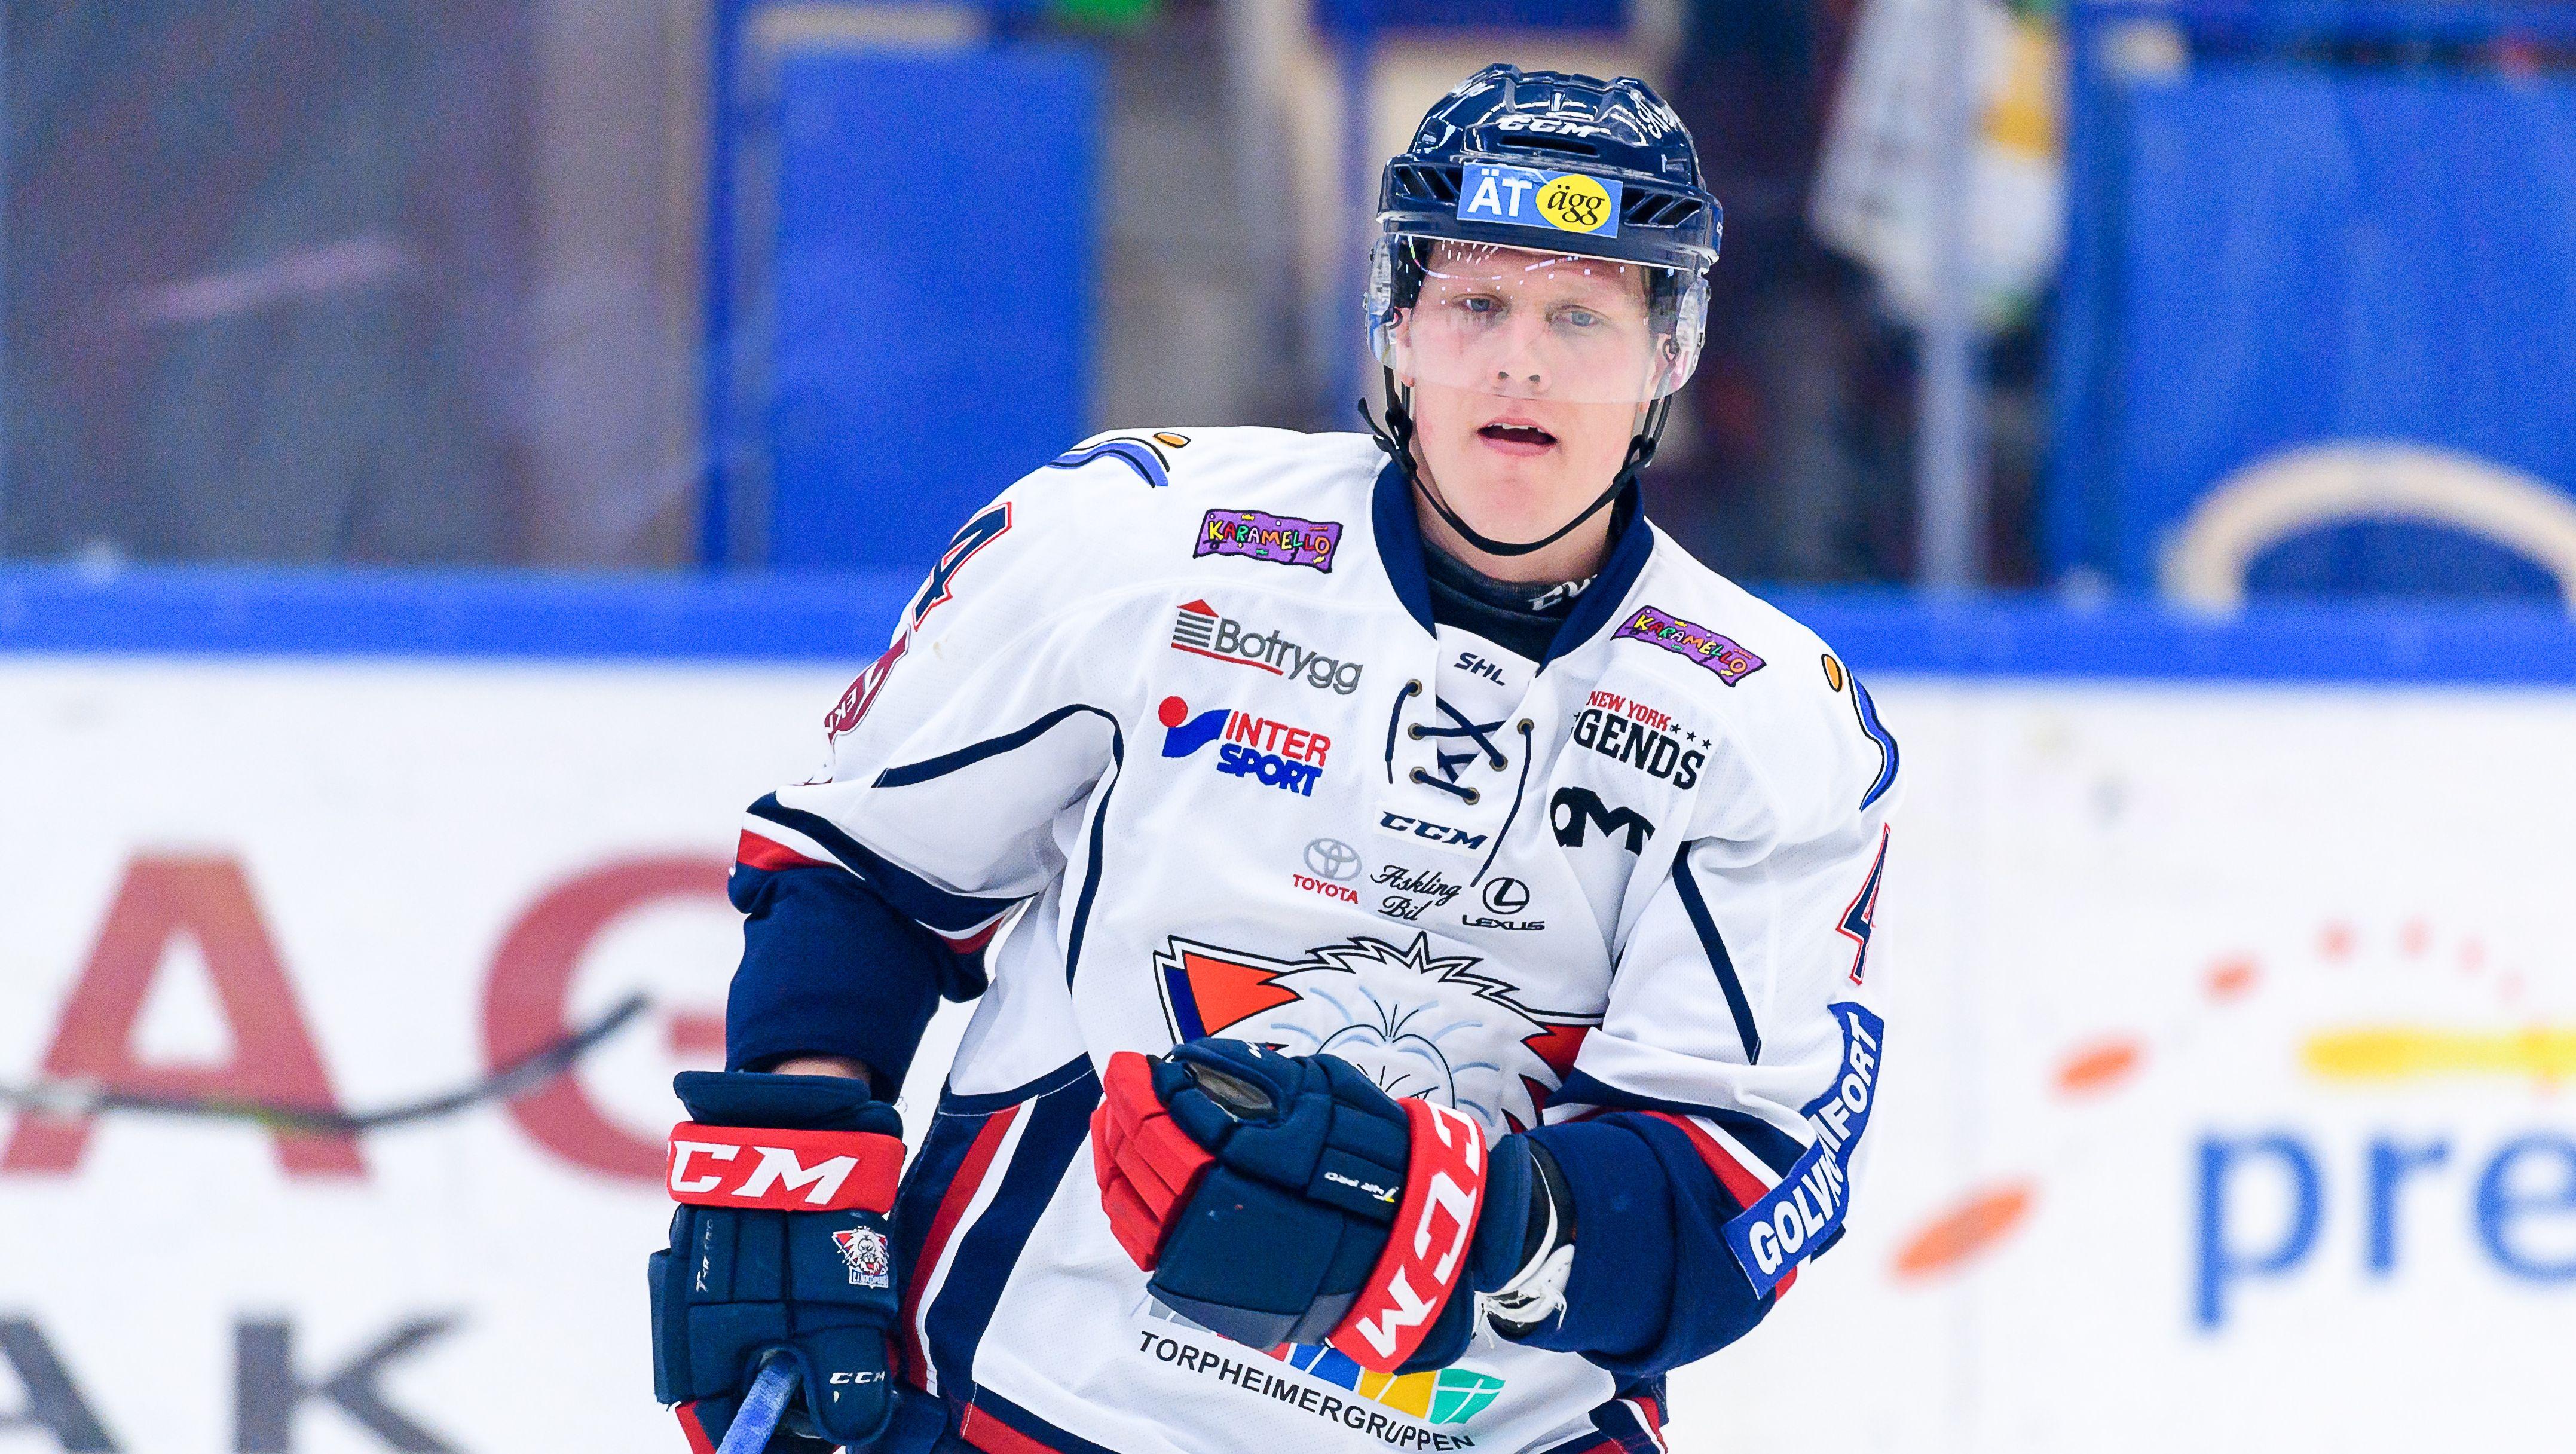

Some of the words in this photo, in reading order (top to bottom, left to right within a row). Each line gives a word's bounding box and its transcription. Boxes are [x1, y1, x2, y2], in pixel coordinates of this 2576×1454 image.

[1498, 117, 1593, 138] CCM
[1467, 168, 1532, 217] ÄT
[1547, 185, 1605, 225] ägg
[1208, 520, 1331, 555] KARAMELLO
[1214, 617, 1363, 695] Botrygg
[1633, 614, 1748, 674] KARAMELLO
[1454, 651, 1506, 687] SHL
[1586, 691, 1626, 712] NEW
[1627, 700, 1671, 731] YORK
[1226, 711, 1331, 767] INTER
[1571, 708, 1705, 790] GENDS
[1216, 743, 1323, 797] SPORT
[1380, 810, 1488, 850] CCM
[1293, 874, 1359, 904] TOYOTA
[1370, 864, 1463, 907] Askling
[1378, 895, 1433, 922] Bil
[1462, 914, 1545, 930] LEXUS
[668, 1140, 859, 1205] CM
[1356, 1100, 1480, 1358] CCM
[830, 1371, 885, 1384] CCM
[1140, 1331, 1476, 1452] TORPHEIMERGRUPPEN
